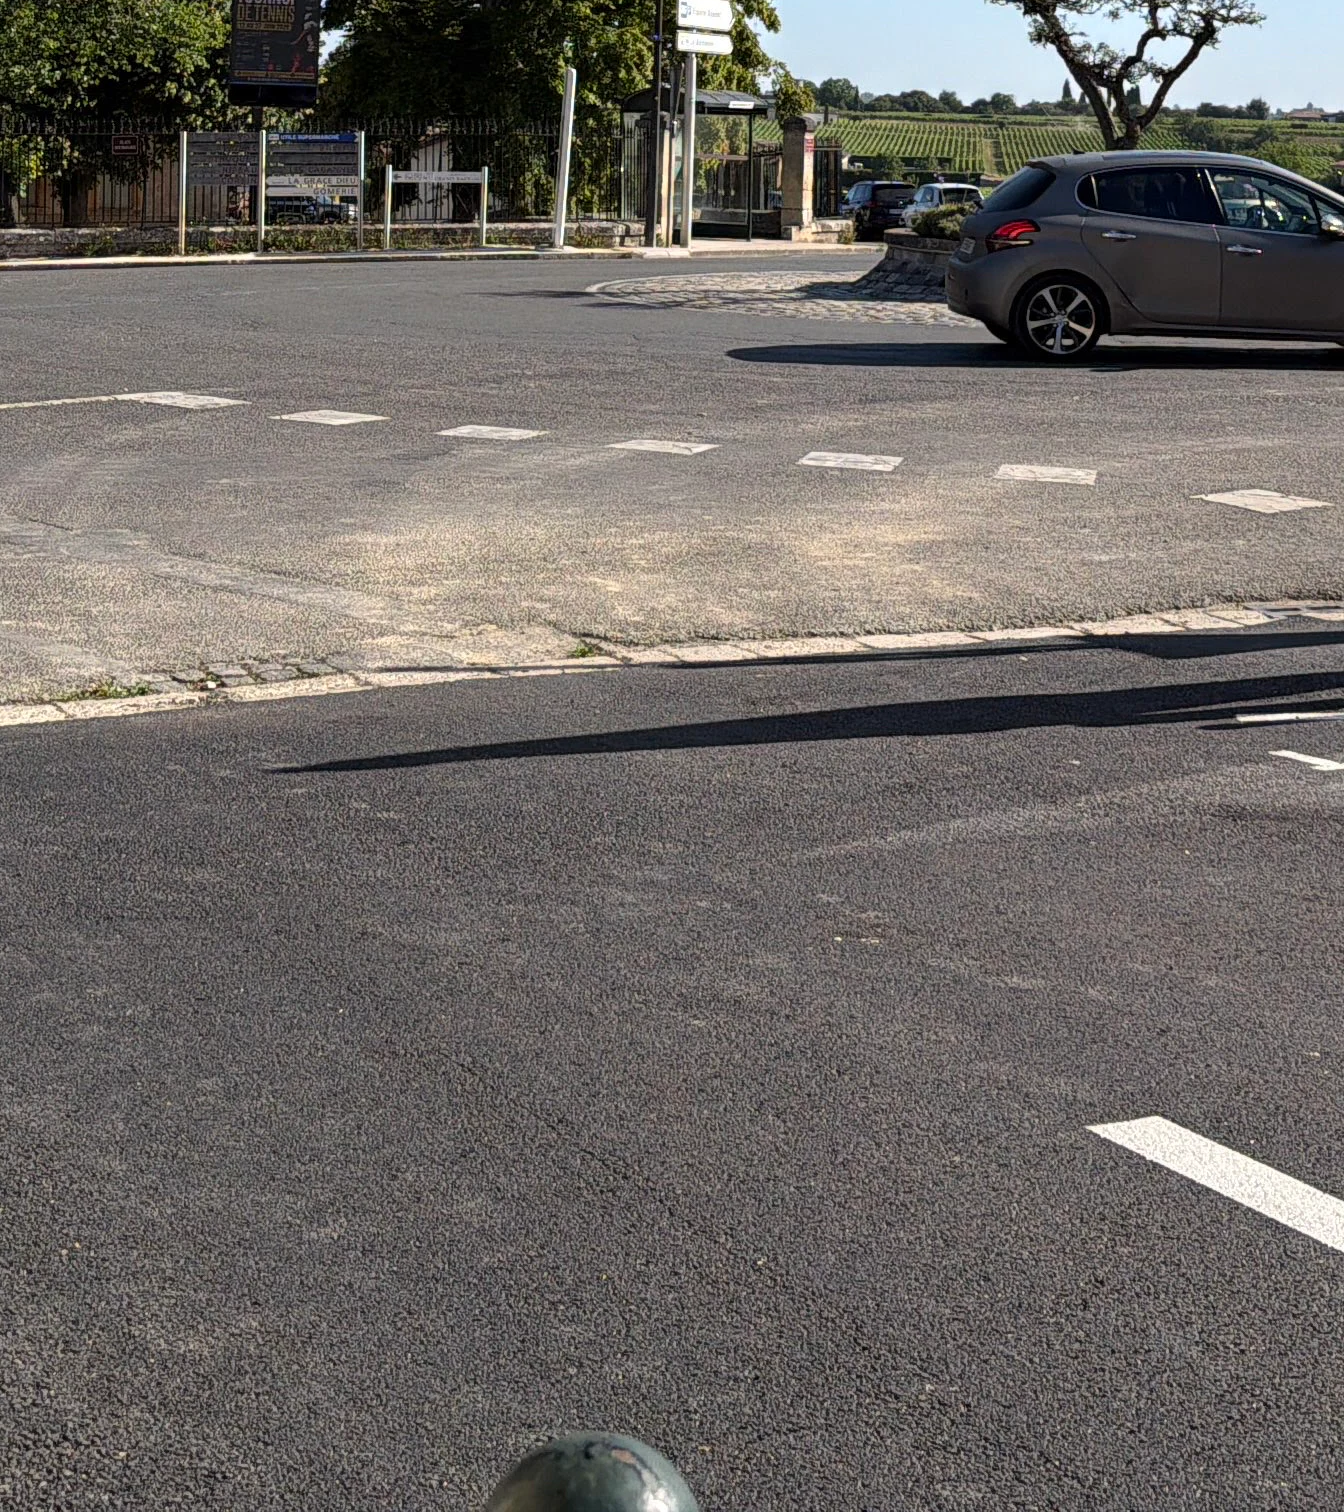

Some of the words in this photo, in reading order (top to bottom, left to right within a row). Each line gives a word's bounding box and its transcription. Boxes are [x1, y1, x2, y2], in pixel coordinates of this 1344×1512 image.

[237, 3, 249, 21] DE
[255, 4, 296, 23] TENNIS
[303, 177, 333, 185] GRACE
